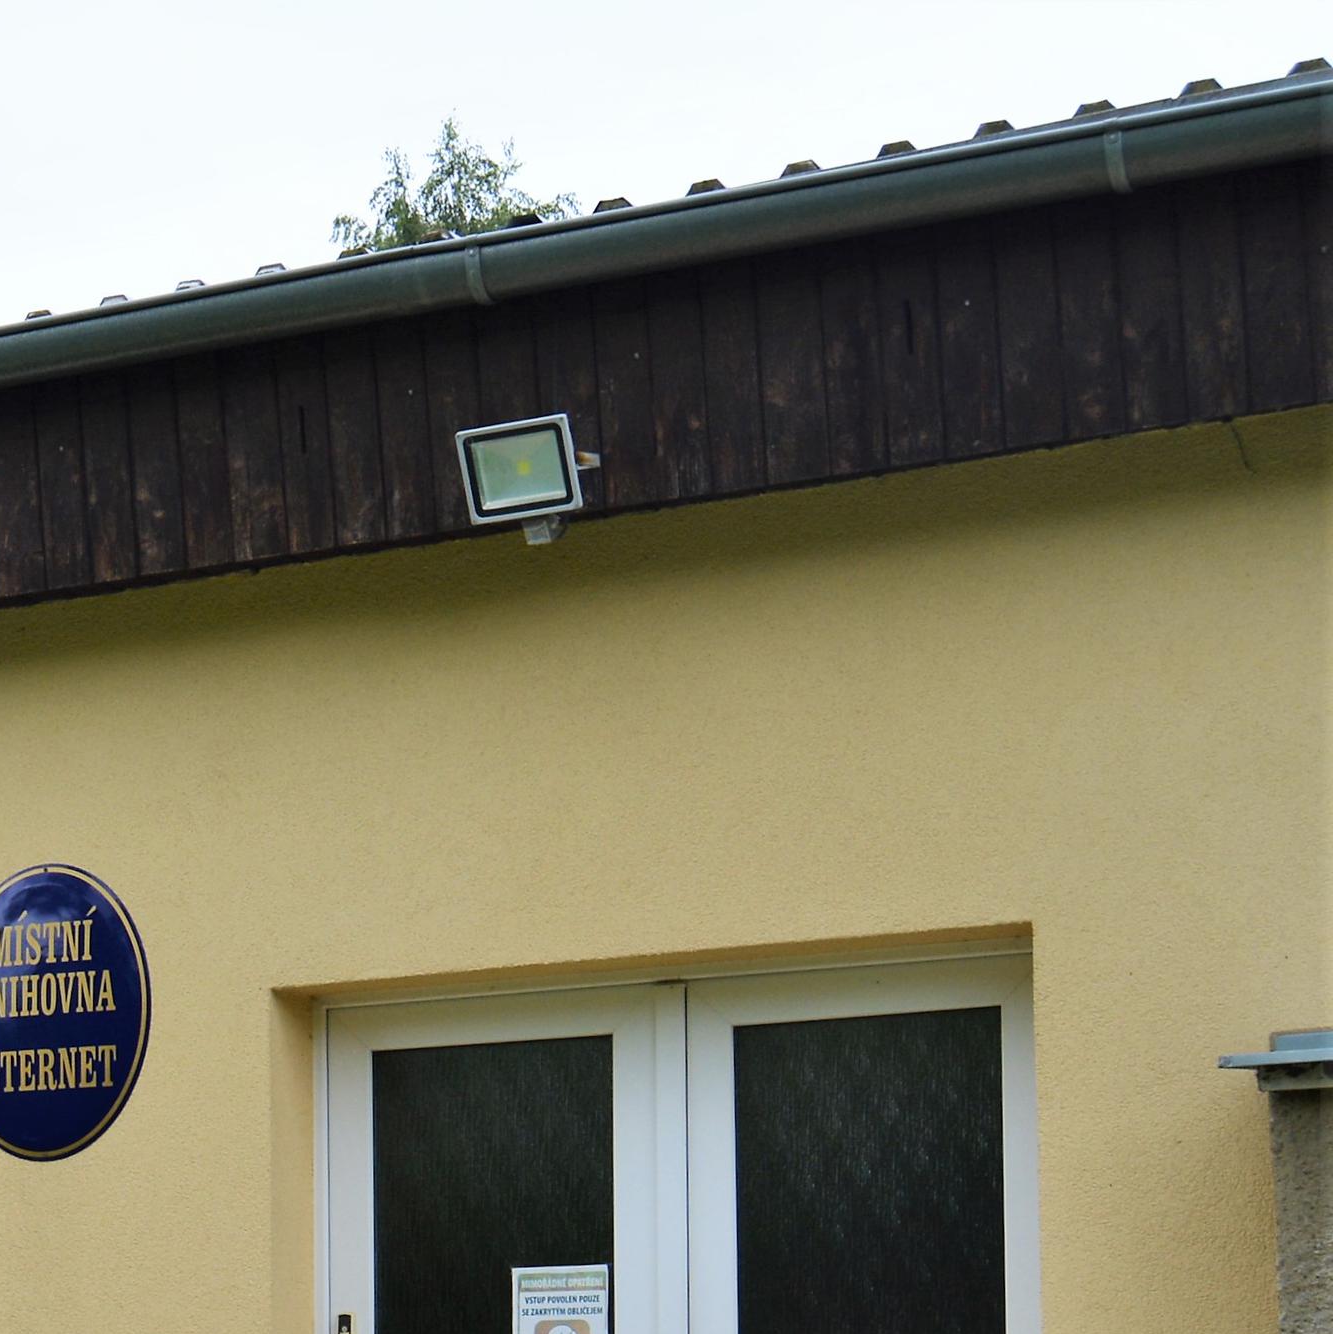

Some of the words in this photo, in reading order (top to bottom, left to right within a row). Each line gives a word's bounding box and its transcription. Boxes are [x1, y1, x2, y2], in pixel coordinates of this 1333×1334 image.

[524, 1296, 546, 1304] VSTUP
[547, 1295, 577, 1304] POVOLEN
[579, 1294, 600, 1303] POUZE
[521, 1308, 529, 1316] SE
[530, 1307, 566, 1316] ZAKRYTÝM
[567, 1306, 603, 1315] OBLIČEJEM
